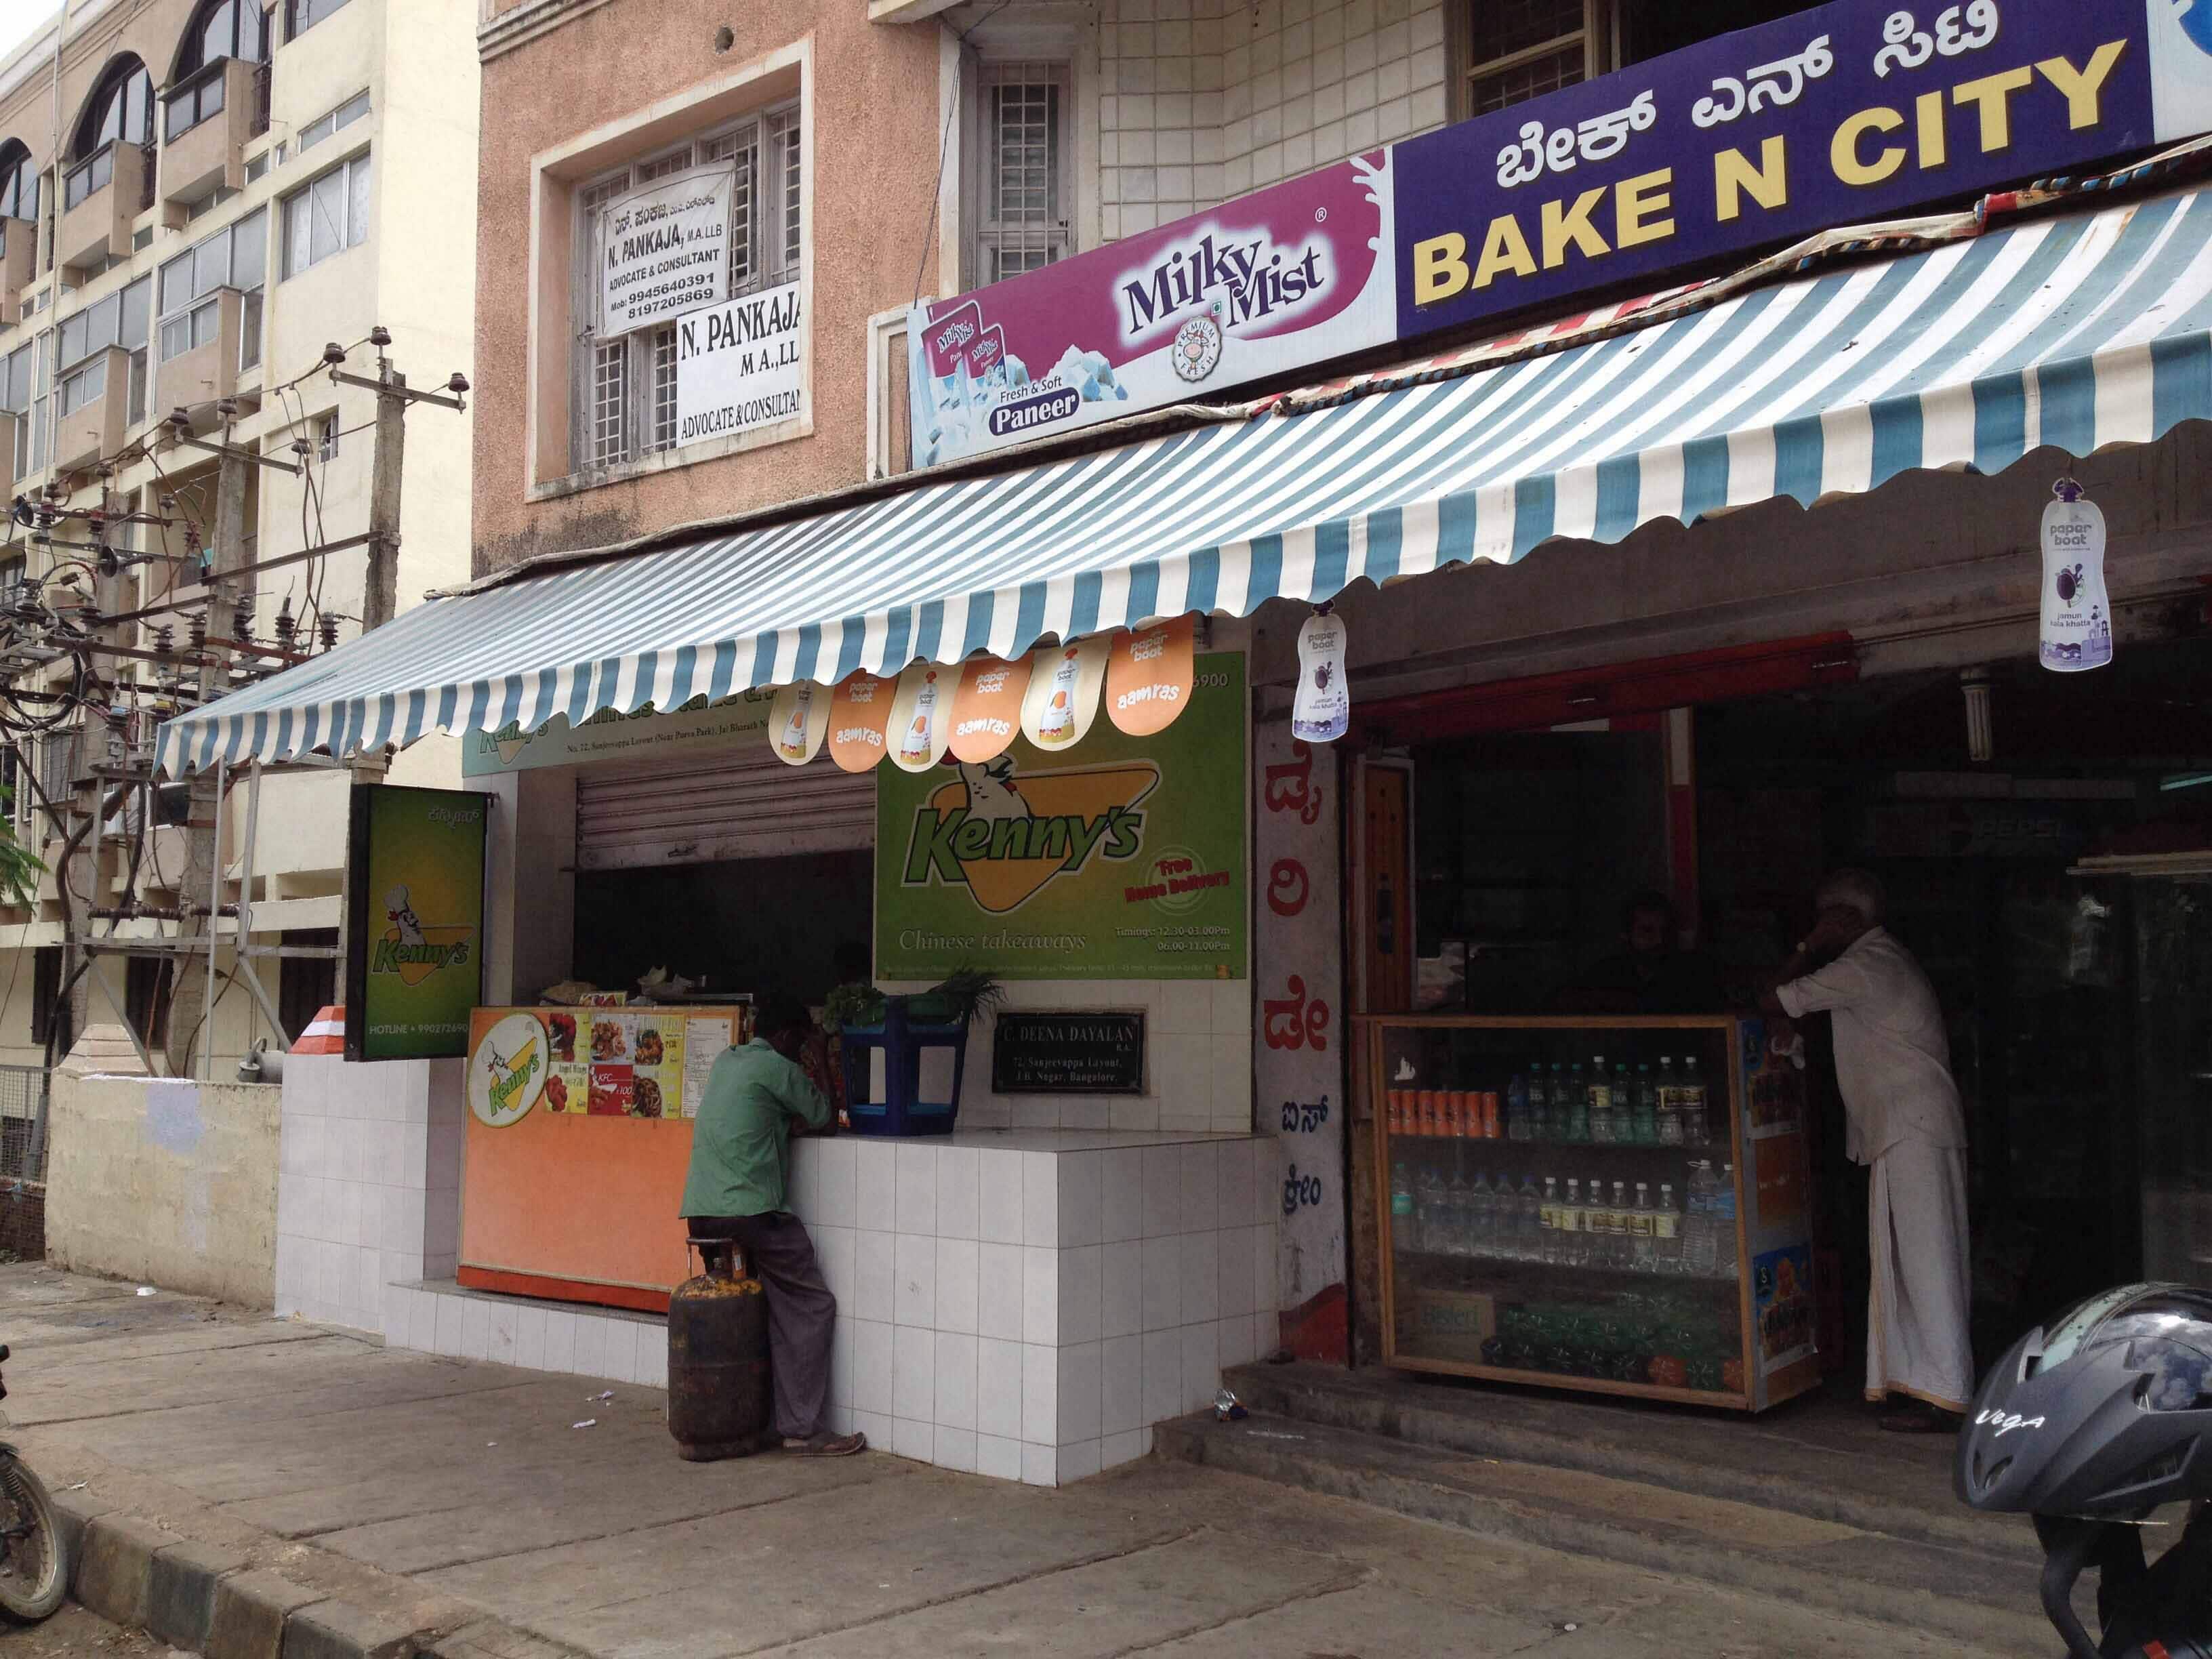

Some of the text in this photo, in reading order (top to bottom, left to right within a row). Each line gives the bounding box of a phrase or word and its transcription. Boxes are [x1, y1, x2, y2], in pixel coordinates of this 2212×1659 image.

[1496, 89, 1656, 188] ಬೇಕ್
[1692, 35, 1834, 129] ಎನ್
[1413, 39, 2128, 306] BAKE N CITY
[609, 245, 618, 270] N.
[622, 223, 684, 264] PANKAJA,
[609, 249, 720, 292] ADVOCATE & CONSULTANT
[1122, 234, 1325, 335] Milky Mist
[611, 272, 714, 312] Mob: 9945640391
[628, 288, 714, 319] 8197205869
[681, 321, 700, 361] N.
[1000, 375, 1063, 403] Fresh & Soft
[681, 405, 734, 440] ADVOCATE
[996, 394, 1076, 433] Paneer
[2050, 525, 2092, 537] paper
[2055, 534, 2087, 546] boat
[2057, 612, 2082, 621] jamun
[1130, 633, 1168, 655] paper
[1133, 647, 1163, 662] boat
[976, 672, 1010, 685] paper
[977, 682, 1003, 694] boat
[1118, 683, 1181, 709] aamras
[836, 727, 882, 746] aamras
[956, 717, 1010, 736] aamras
[903, 806, 1143, 884] Kenny's
[899, 927, 1088, 954] Chinese takeaways
[373, 939, 469, 972] Kenny's
[369, 1024, 407, 1034] HOTLINE
[489, 1053, 539, 1117] Kenny's
